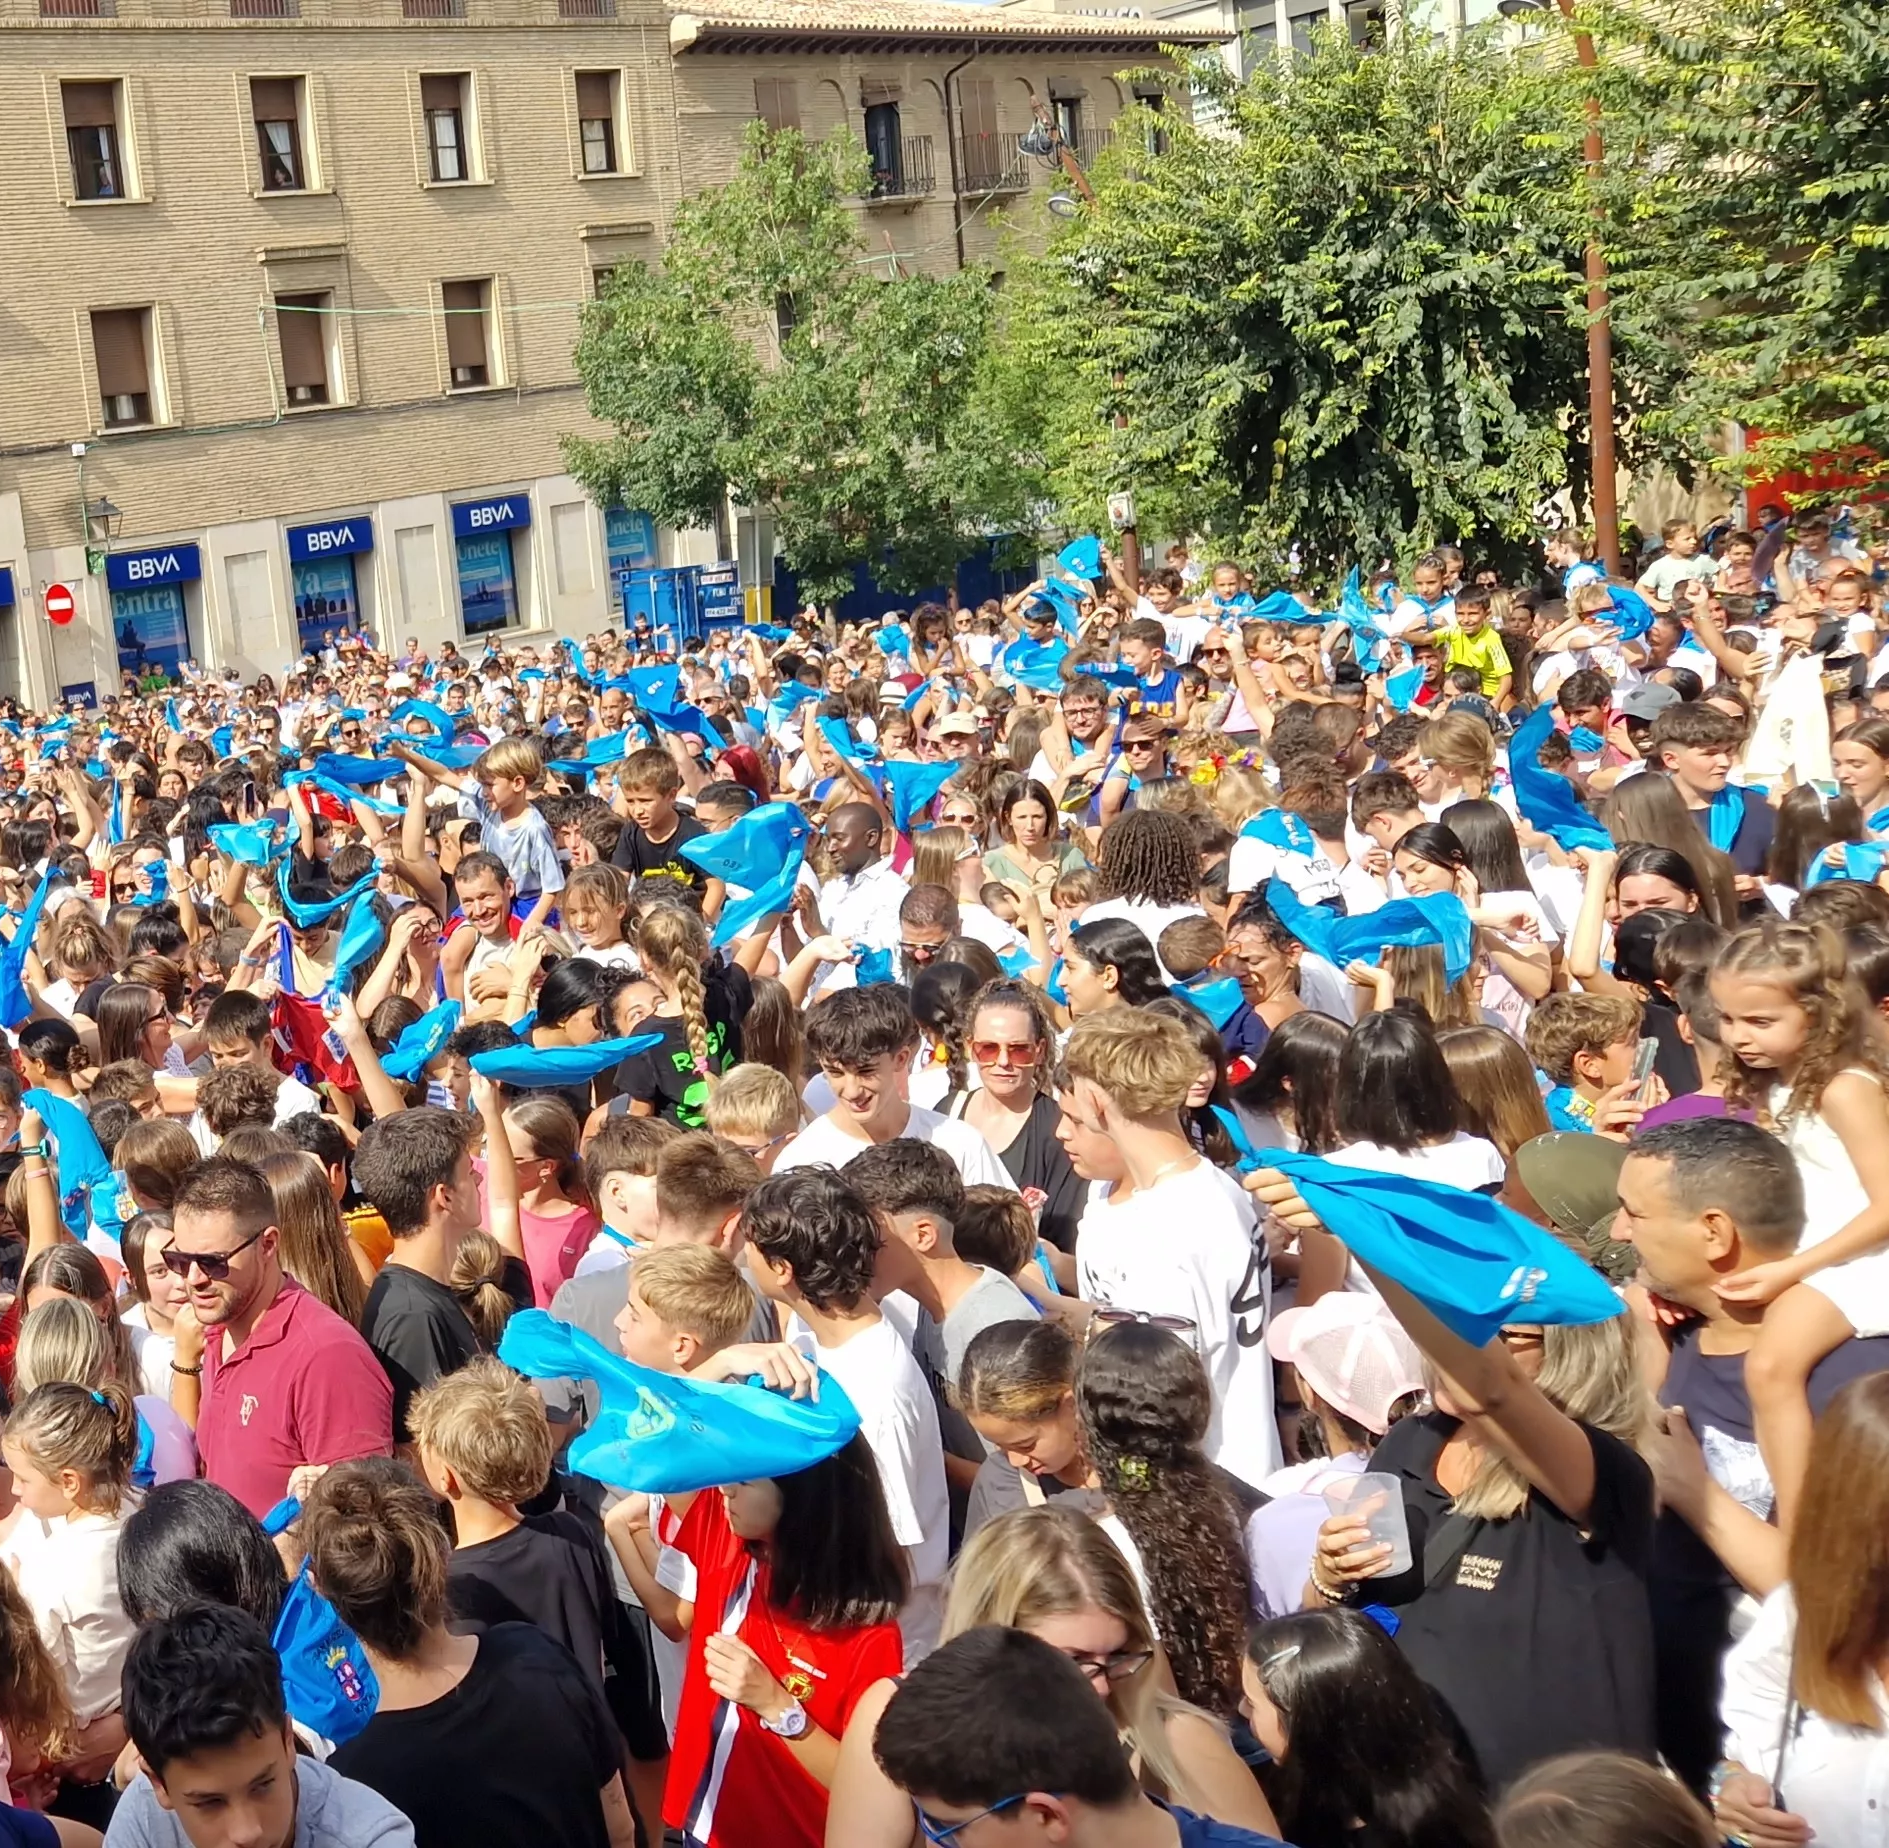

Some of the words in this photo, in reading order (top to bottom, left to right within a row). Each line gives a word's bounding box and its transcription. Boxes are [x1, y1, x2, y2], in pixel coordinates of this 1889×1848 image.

[470, 502, 514, 527] BBVA
[307, 525, 355, 552] BBVA
[128, 553, 180, 580] BBVA
[112, 588, 179, 618] Entra
[68, 691, 92, 705] BBVA
